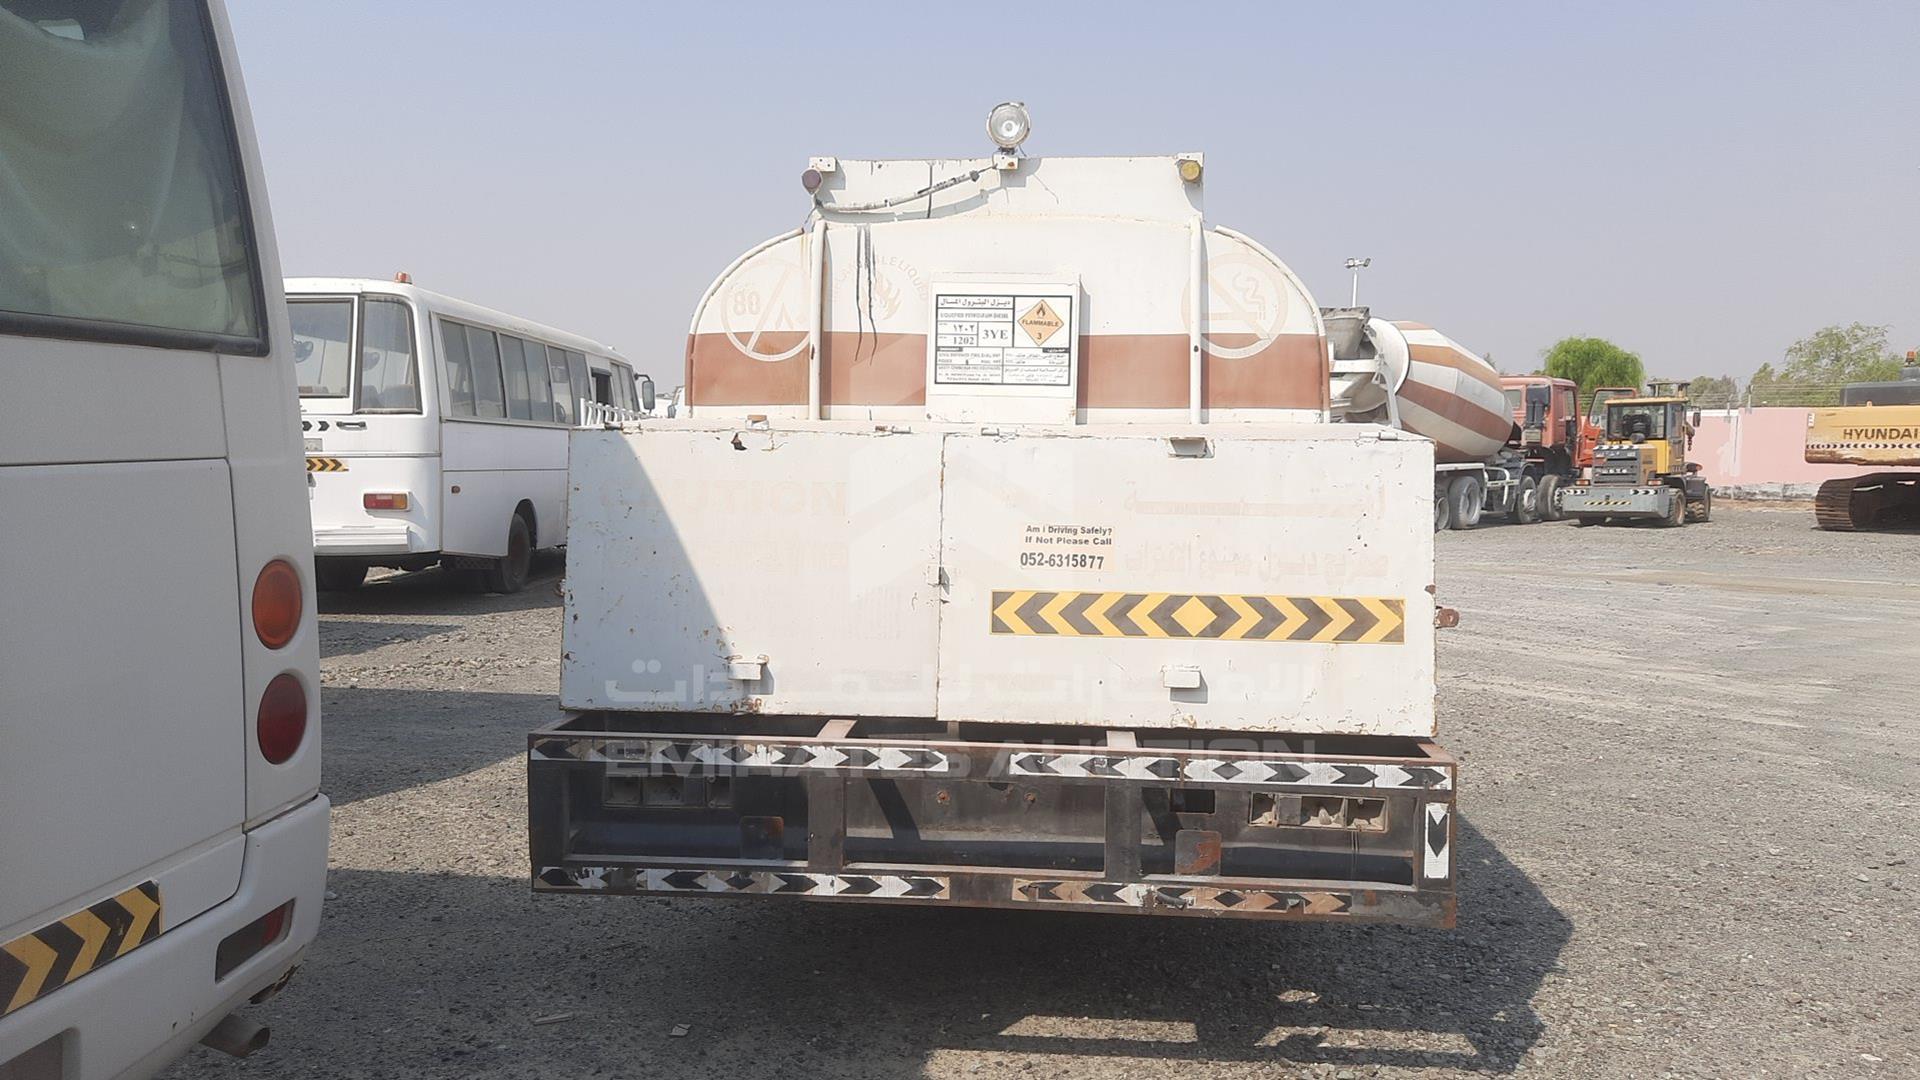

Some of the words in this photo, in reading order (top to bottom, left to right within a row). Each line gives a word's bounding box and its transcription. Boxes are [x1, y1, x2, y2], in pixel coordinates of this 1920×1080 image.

[1021, 319, 1059, 328] FLAMMABLE
[982, 329, 1009, 340] 3YE
[1037, 332, 1042, 340] 3
[953, 337, 974, 345] 1202
[1843, 428, 1918, 440] HYUNDAI
[1026, 525, 1040, 533] Am
[1048, 525, 1078, 536] Driving
[1080, 526, 1112, 536] Safely?
[1035, 536, 1053, 544] Not
[1056, 537, 1090, 545] Please
[1092, 537, 1112, 545] Call
[1020, 552, 1105, 570] 052-6315877
